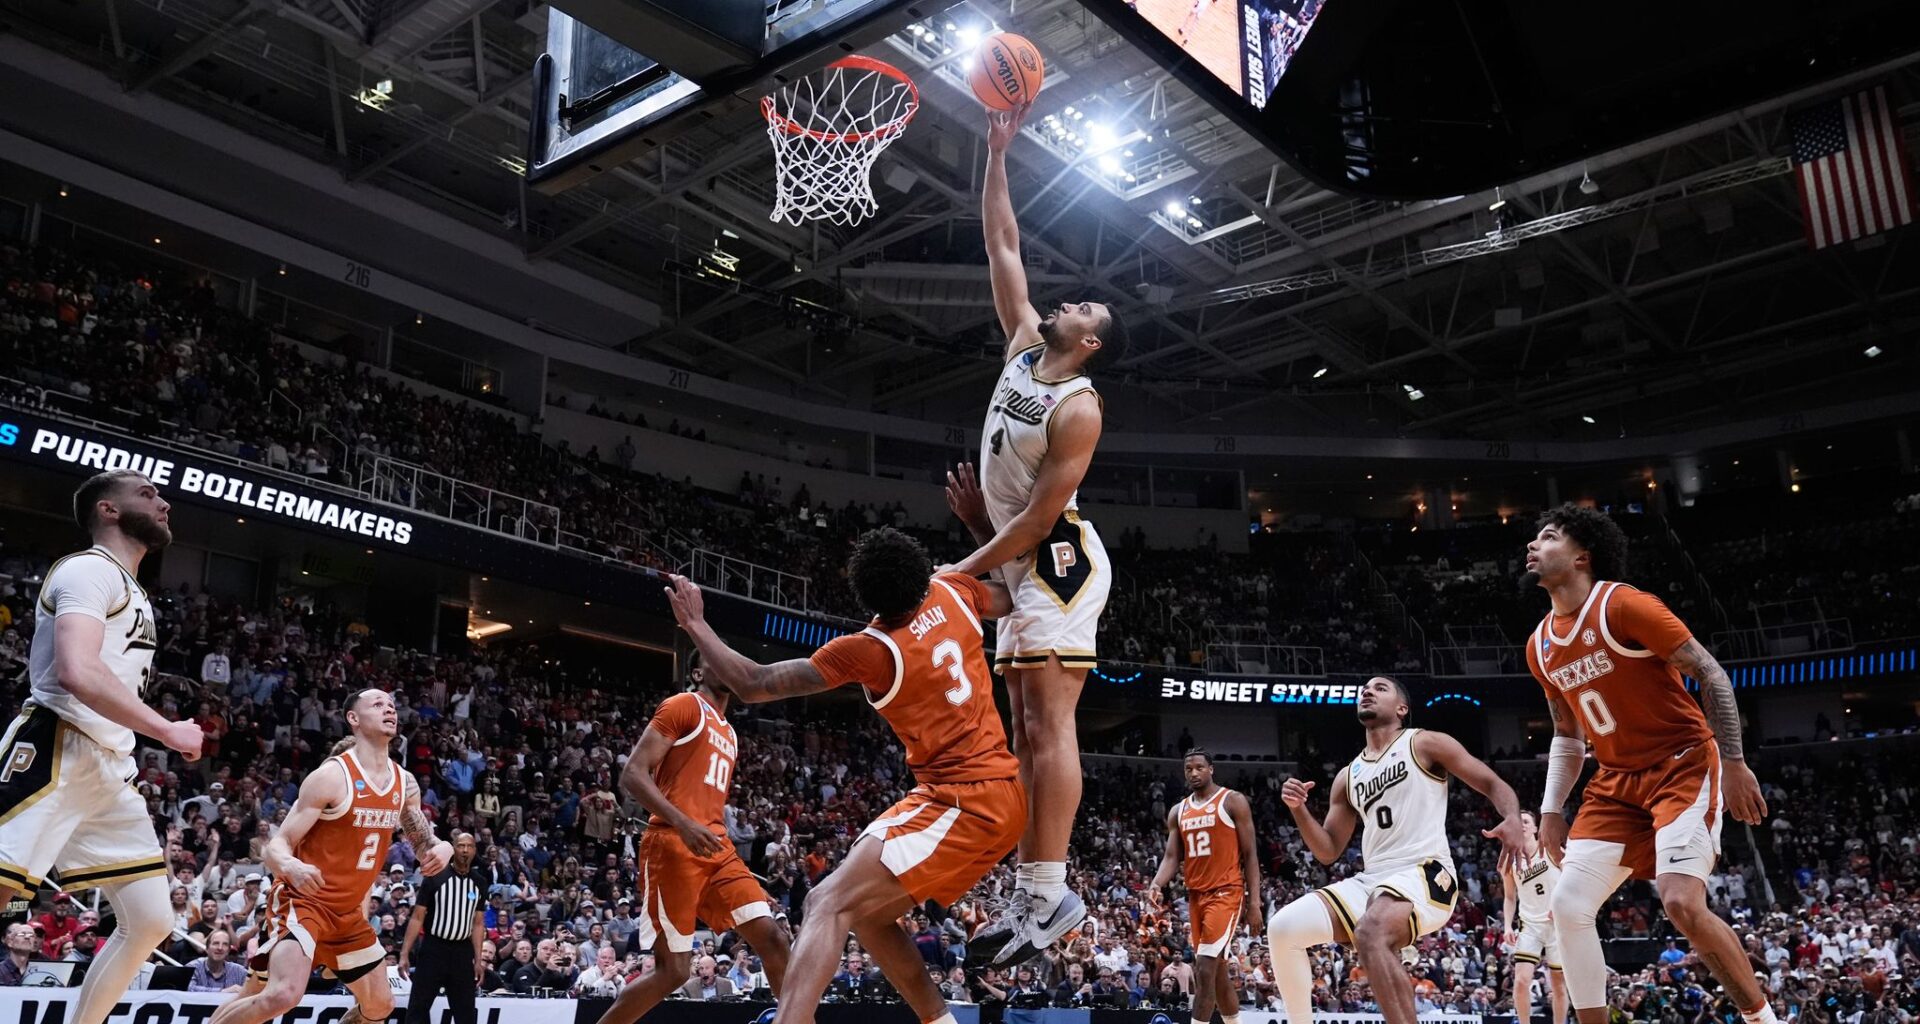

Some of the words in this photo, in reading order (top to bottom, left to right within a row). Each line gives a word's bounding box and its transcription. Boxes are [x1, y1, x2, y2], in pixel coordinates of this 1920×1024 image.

[1244, 4, 1262, 59] SWEET
[992, 46, 1020, 96] Wilson
[1247, 53, 1266, 111] SIXTEE
[345, 262, 370, 288] 216
[669, 369, 690, 390] 217
[994, 377, 1047, 425] Purdue
[945, 426, 965, 444] 218
[990, 427, 1005, 456] 4
[1214, 435, 1236, 452] 219
[1486, 442, 1510, 458] 220
[30, 429, 175, 486] PURDUE
[180, 467, 413, 545] BOILERMAKERS
[1050, 541, 1077, 577] P
[908, 605, 948, 641] SWAIN
[932, 638, 973, 706] 3
[1549, 648, 1615, 692] TEXAS
[1190, 680, 1268, 703] SWEET
[1579, 688, 1617, 737] 0
[0, 741, 37, 783] P
[703, 751, 730, 794] 10
[1354, 760, 1409, 816] Purdue
[352, 807, 400, 829] TEXAS
[1181, 814, 1216, 832] TEXAS
[1376, 805, 1393, 829] 0
[356, 832, 380, 870] 2
[1187, 830, 1212, 858] 12
[1534, 883, 1545, 896] 2
